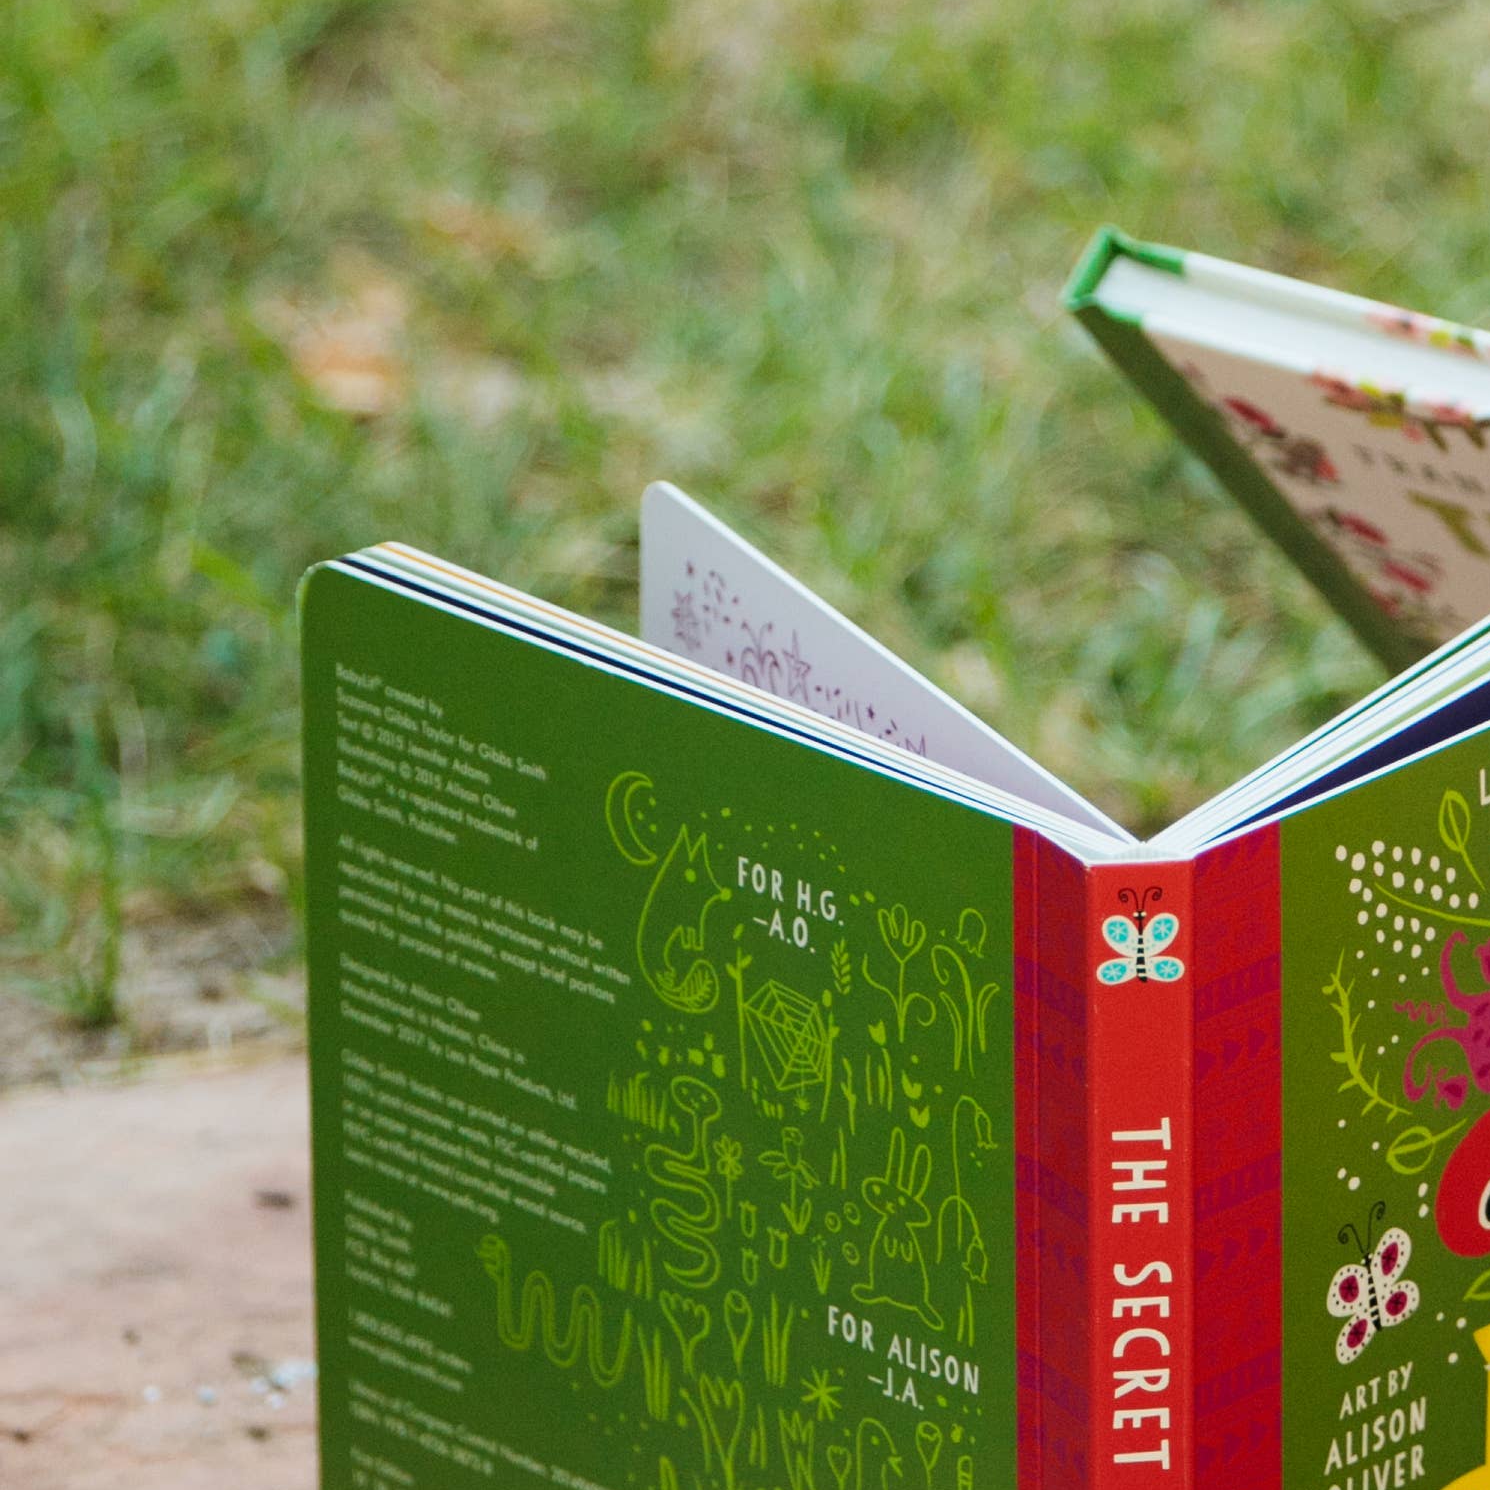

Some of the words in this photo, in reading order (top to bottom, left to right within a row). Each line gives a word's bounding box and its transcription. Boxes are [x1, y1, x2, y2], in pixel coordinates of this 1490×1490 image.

[517, 756, 546, 781] Smith
[738, 856, 784, 902] FOR
[796, 879, 844, 926] H.G.
[1111, 1117, 1172, 1223] THE
[828, 1305, 873, 1352] FOR
[888, 1334, 979, 1395] ALISON
[1112, 1261, 1172, 1470] SECRET
[1339, 1375, 1380, 1420] ART
[1387, 1362, 1413, 1396] BY
[1324, 1396, 1427, 1476] ALISON
